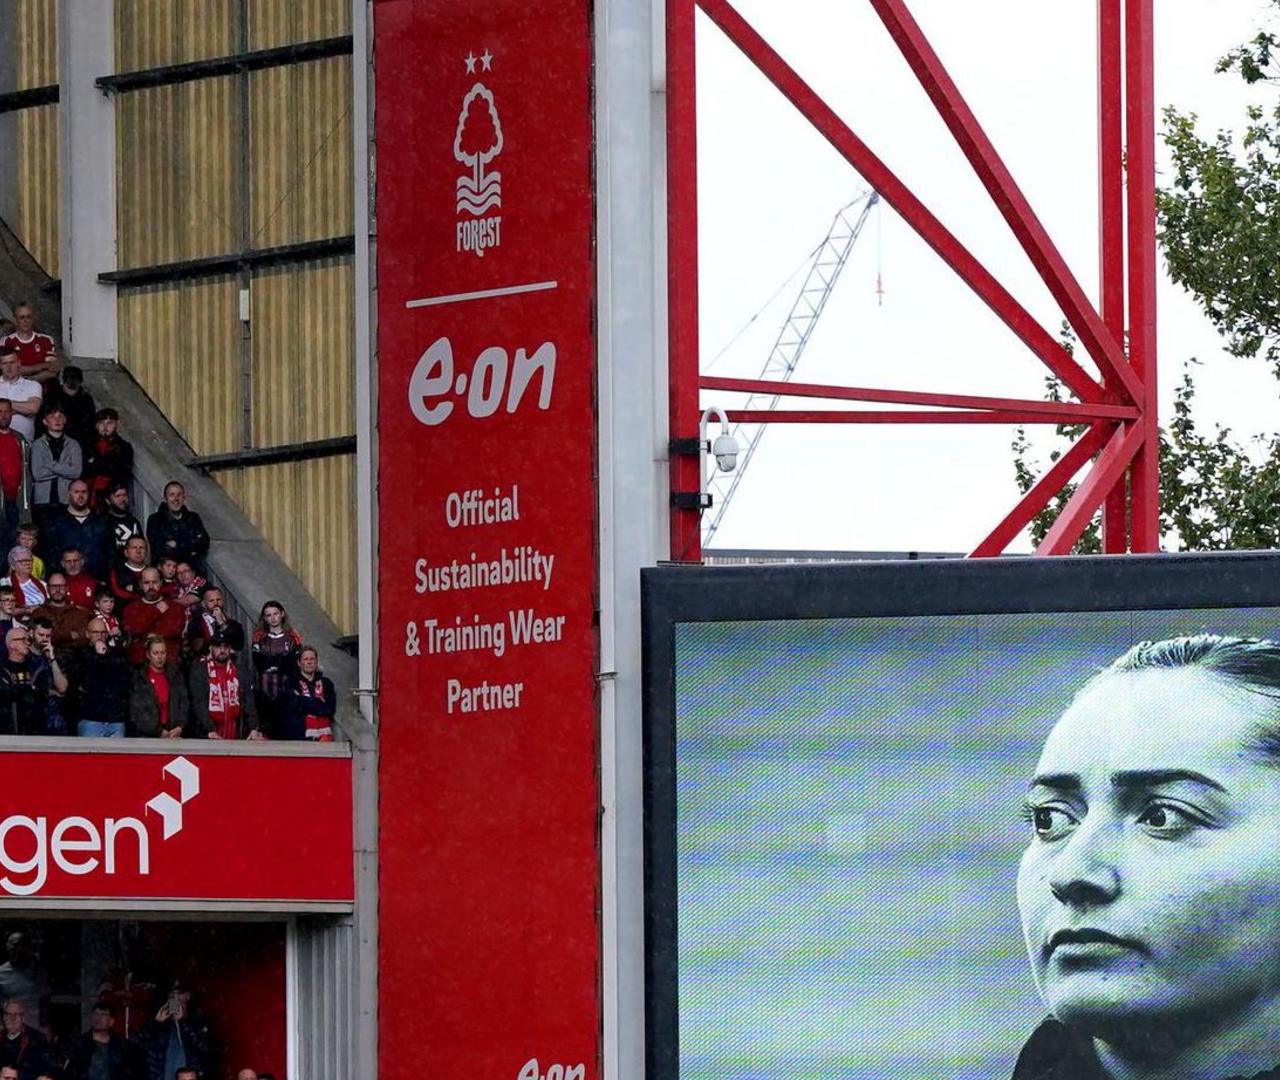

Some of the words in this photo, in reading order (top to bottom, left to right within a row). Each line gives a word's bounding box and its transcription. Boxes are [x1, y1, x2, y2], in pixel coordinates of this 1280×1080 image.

[446, 485, 519, 527] Official
[415, 546, 554, 593] Sustainability
[406, 621, 420, 656] &
[425, 619, 504, 656] Training
[509, 609, 565, 645] Wear
[448, 679, 523, 713] Partner
